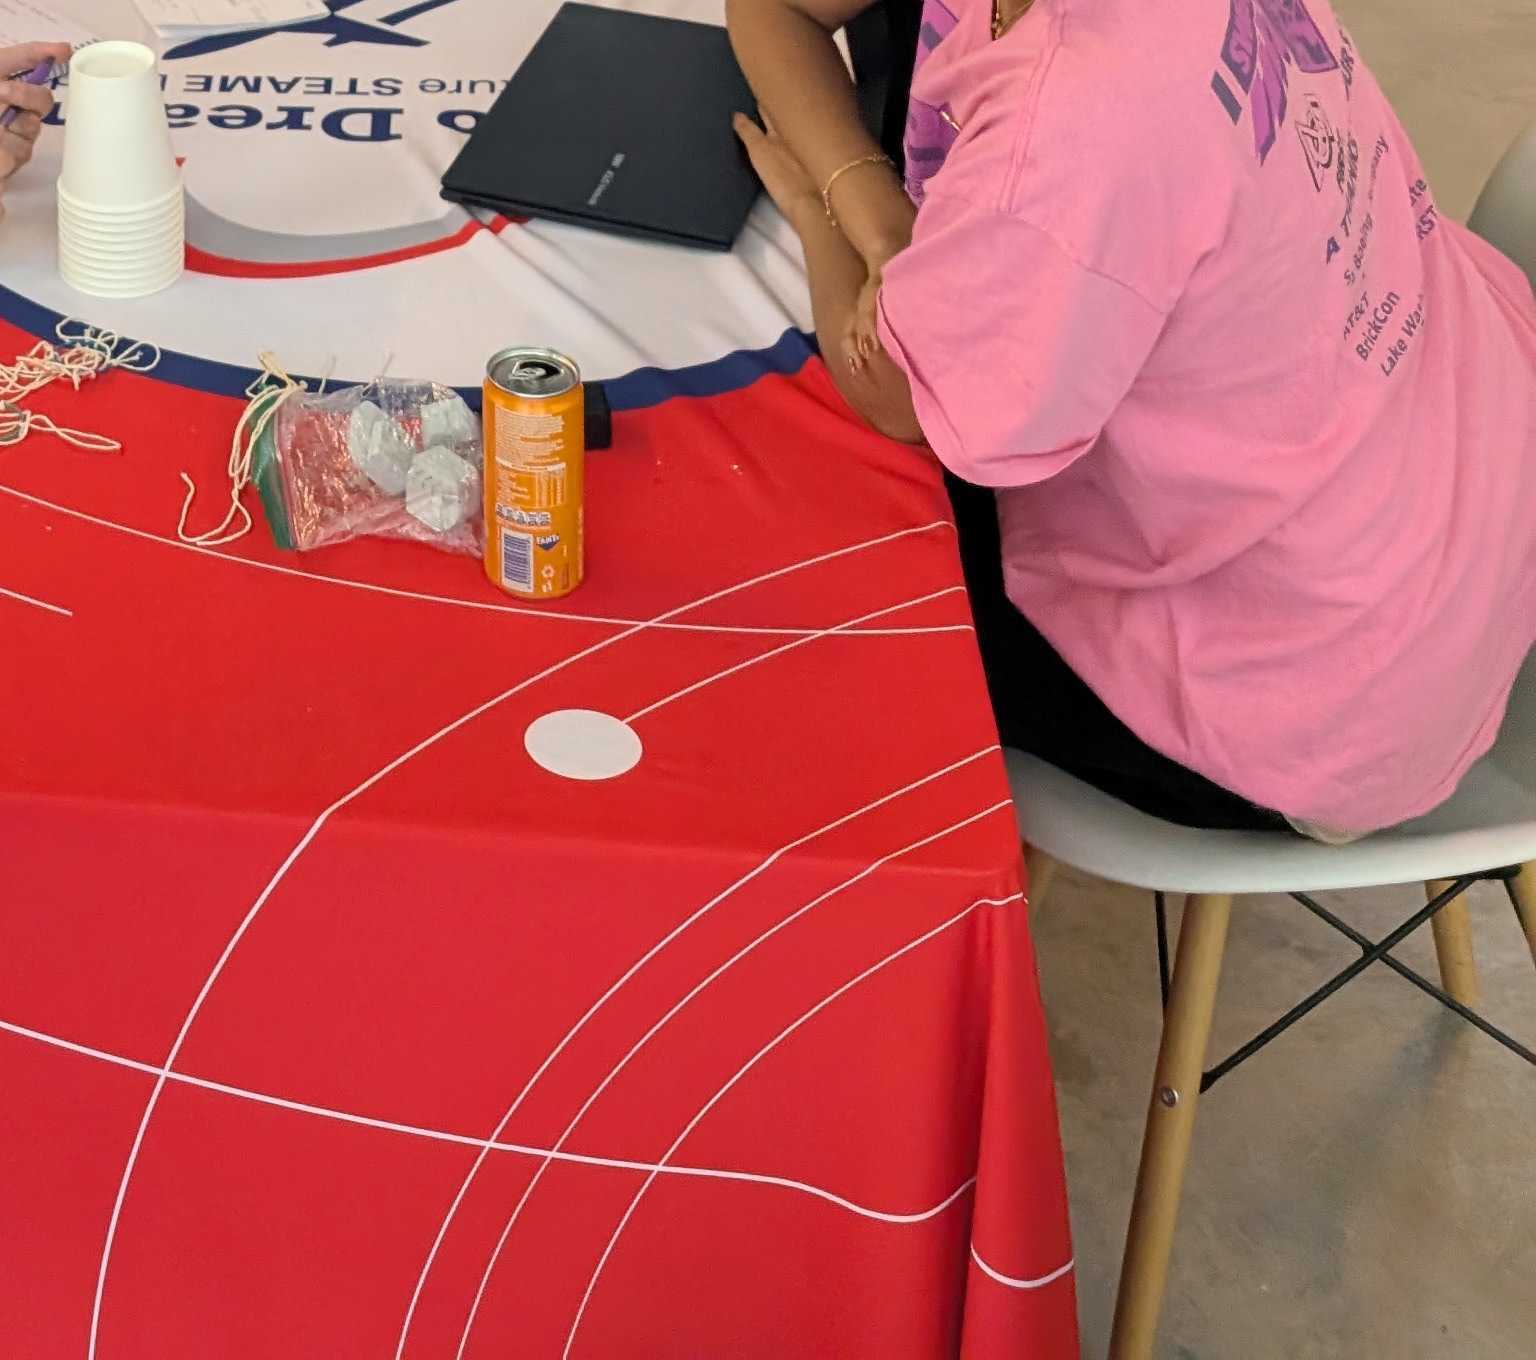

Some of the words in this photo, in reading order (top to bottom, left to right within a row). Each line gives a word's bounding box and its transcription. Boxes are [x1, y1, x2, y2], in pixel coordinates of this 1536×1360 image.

[183, 73, 402, 96] STEAME
[1355, 291, 1401, 362] BrickCon
[1380, 338, 1408, 377] Lake
